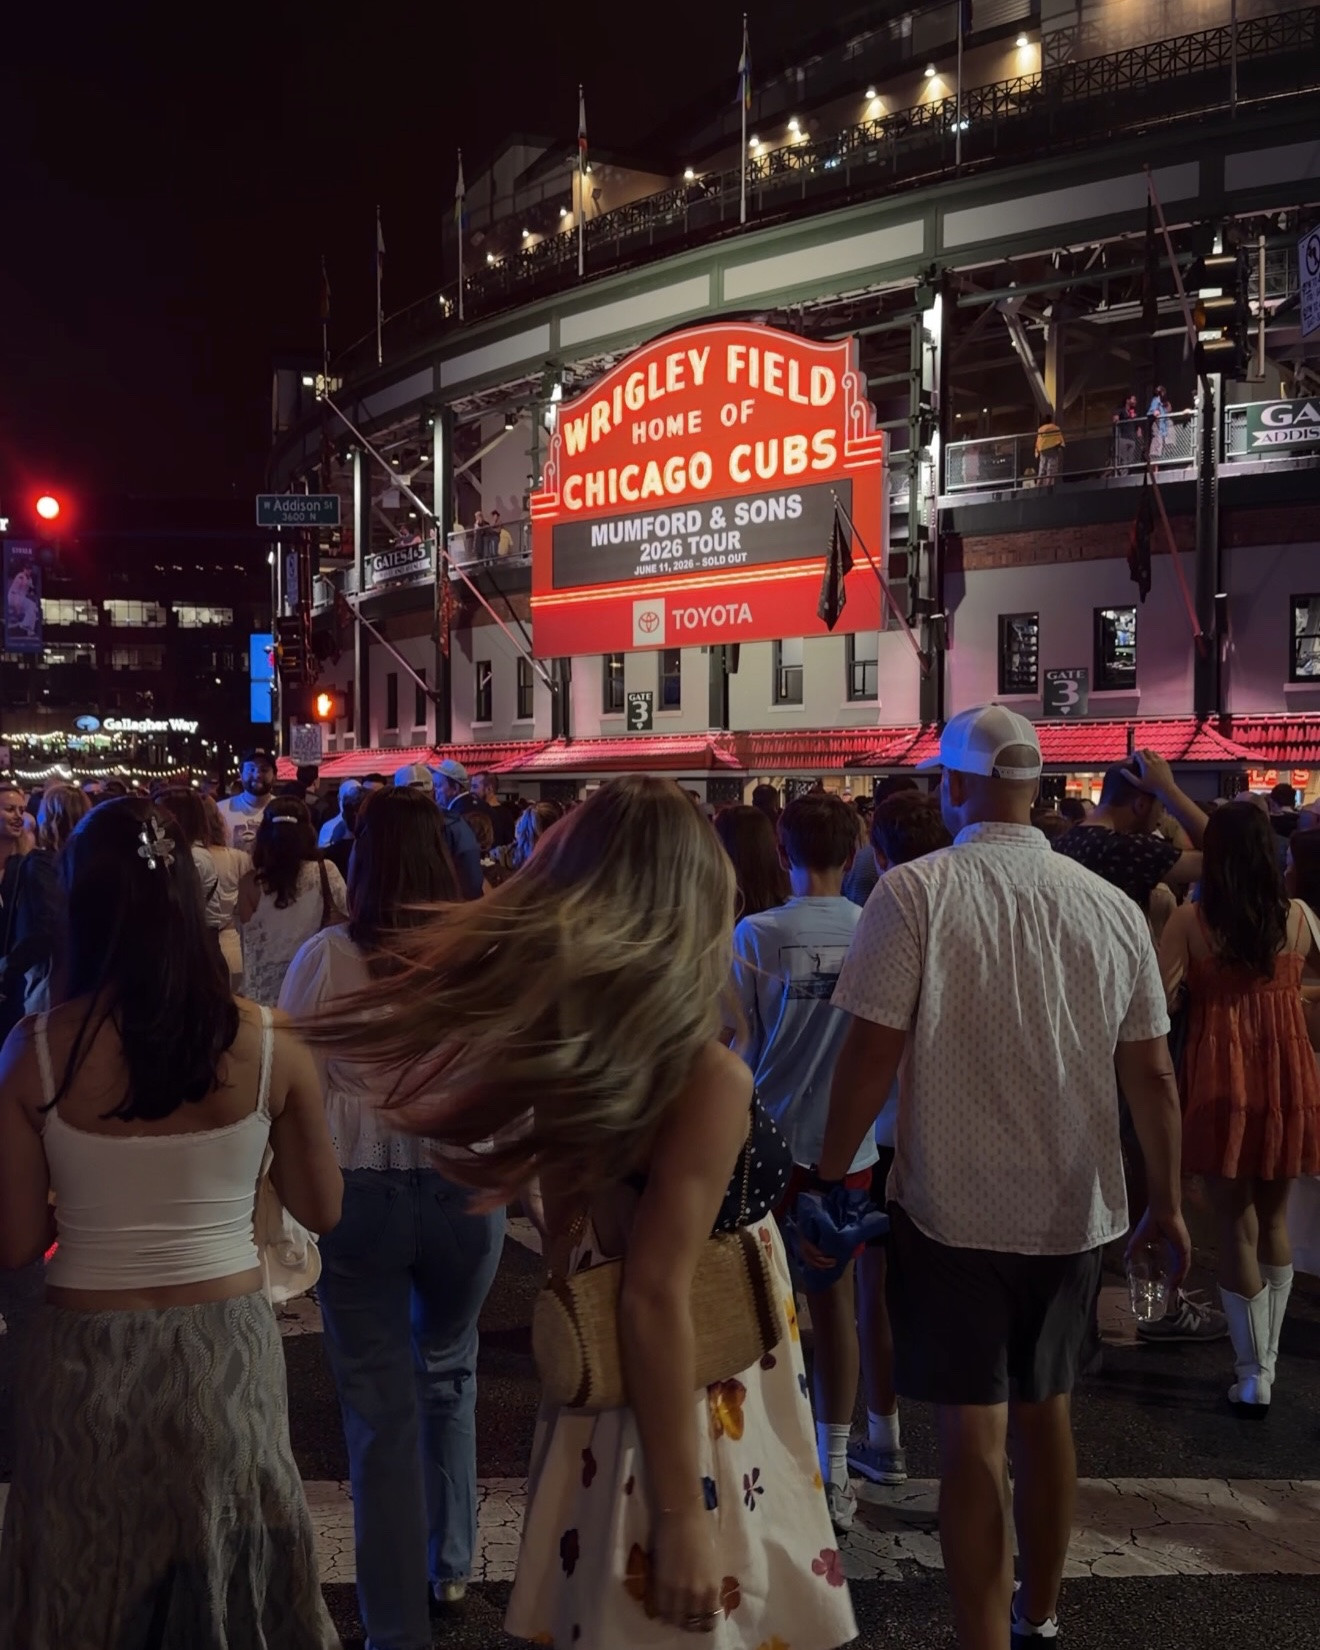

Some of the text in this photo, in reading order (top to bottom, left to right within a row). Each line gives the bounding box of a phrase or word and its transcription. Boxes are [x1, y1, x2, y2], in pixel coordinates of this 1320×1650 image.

[563, 344, 837, 457] WRIGLEY FIELD
[631, 398, 756, 445] HOME OF
[562, 428, 838, 511] CHICAGO CUBS
[273, 499, 321, 512] Addison
[282, 512, 316, 521] 3600 N
[590, 493, 803, 548] MUMFORD & SONS
[639, 530, 742, 562] 2026 TOUR
[373, 551, 407, 571] GATES
[633, 564, 657, 576] JUNE
[658, 562, 672, 573] 11,
[673, 559, 694, 571] 2026
[701, 554, 726, 567] SOLD
[727, 552, 748, 564] OUT
[672, 603, 753, 630] TOYOTA
[1047, 670, 1086, 680] GATE
[628, 693, 651, 701] GATE
[1051, 680, 1080, 706] 3
[631, 701, 649, 723] 3
[103, 718, 198, 733] Gallagher Way
